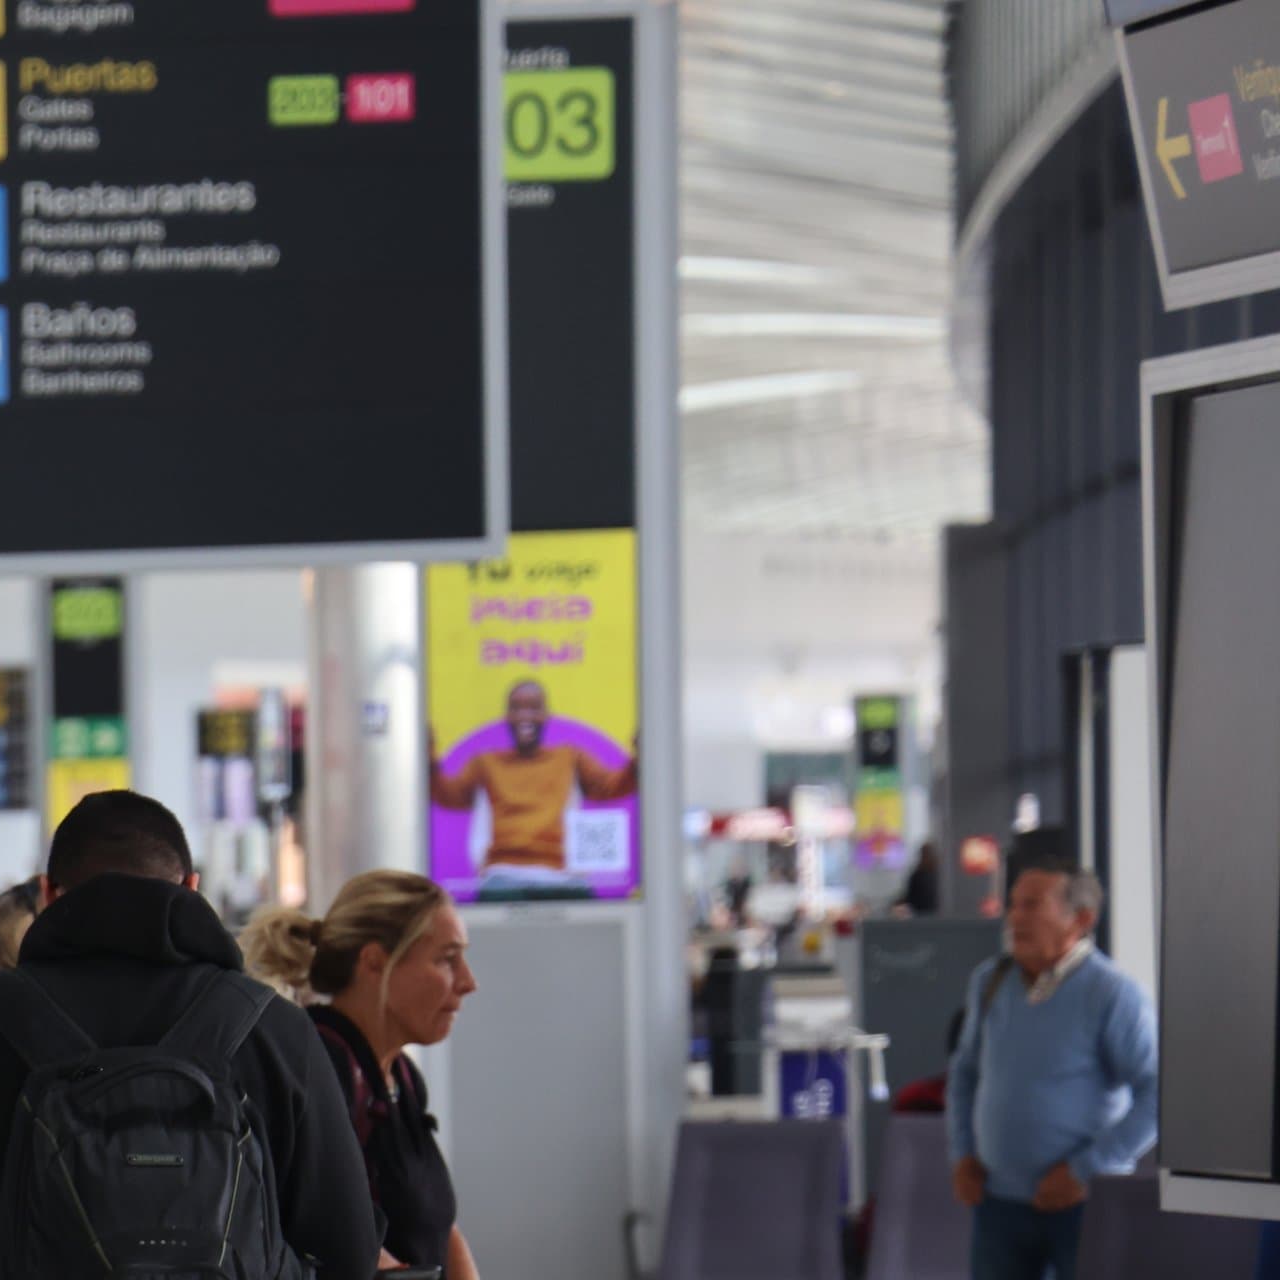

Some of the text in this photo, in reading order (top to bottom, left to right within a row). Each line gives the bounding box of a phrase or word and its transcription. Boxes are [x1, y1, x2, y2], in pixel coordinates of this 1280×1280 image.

[504, 47, 569, 69] uerta
[20, 58, 157, 92] Puertas
[19, 96, 93, 121] Gates
[354, 80, 409, 113] 101
[506, 88, 599, 157] 03
[19, 125, 99, 150] Portas
[22, 179, 256, 217] Restaurantes
[96, 248, 130, 270] de
[22, 302, 136, 337] Baños
[21, 341, 152, 366] Bathrooms
[22, 369, 143, 394] Banheiros
